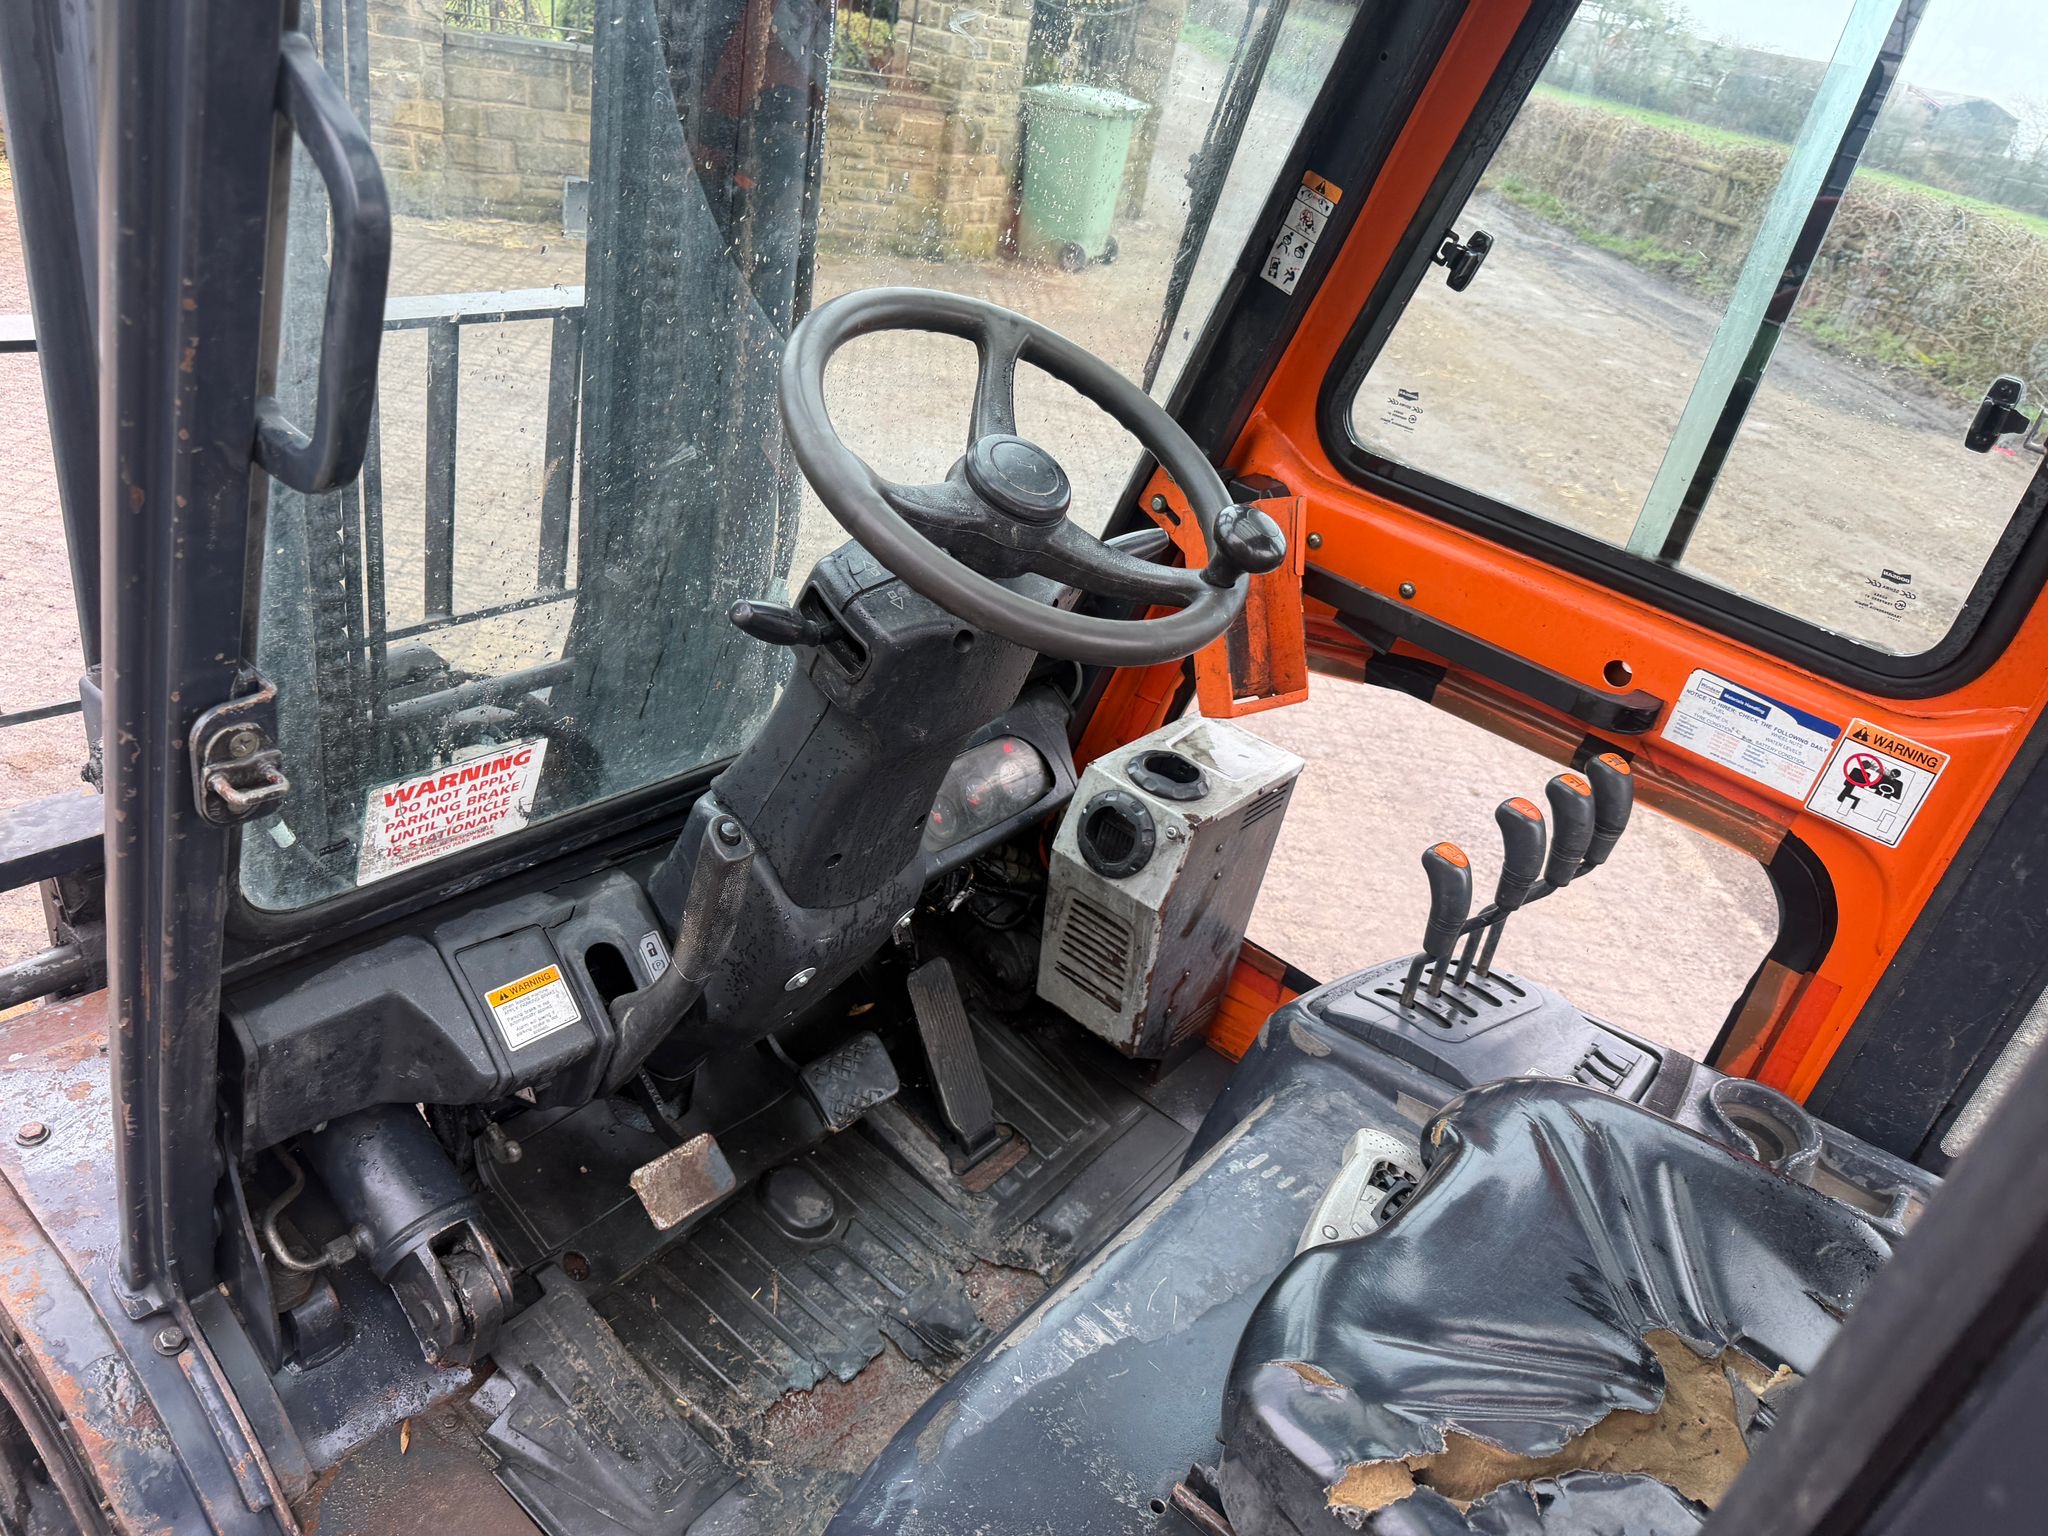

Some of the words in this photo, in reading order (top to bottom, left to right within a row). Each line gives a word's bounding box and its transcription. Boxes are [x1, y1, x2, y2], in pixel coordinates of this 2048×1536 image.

[1702, 710, 1720, 719] ENGINE
[1713, 707, 1725, 715] FUEL
[1744, 702, 1765, 715] Handling
[1686, 689, 1707, 700] NOTICE
[1739, 711, 1759, 723] CHECK
[1760, 721, 1773, 730] THE
[1774, 727, 1809, 746] FOLLOWING
[1810, 742, 1828, 753] DAILY
[1706, 718, 1733, 733] CONDITION
[1755, 740, 1777, 753] BATTERY
[1778, 750, 1806, 765] CONDITION
[1765, 737, 1783, 748] WATER
[1783, 744, 1803, 756] LEVELS
[1771, 732, 1788, 742] WHEEL
[1789, 739, 1803, 749] NUTS
[1873, 734, 1939, 769] WARNING
[383, 749, 532, 808] WARNING
[394, 801, 421, 818] DO
[426, 788, 462, 807] NOT
[466, 770, 517, 794] APPLY
[384, 800, 461, 833] PARKING
[466, 781, 520, 806] BRAKE
[386, 845, 402, 857] IS
[408, 808, 510, 851] STATIONARY
[390, 820, 439, 844] UNTIL
[445, 797, 511, 825] VEHICLE
[452, 838, 470, 847] PARK
[508, 972, 552, 996] WARNING
